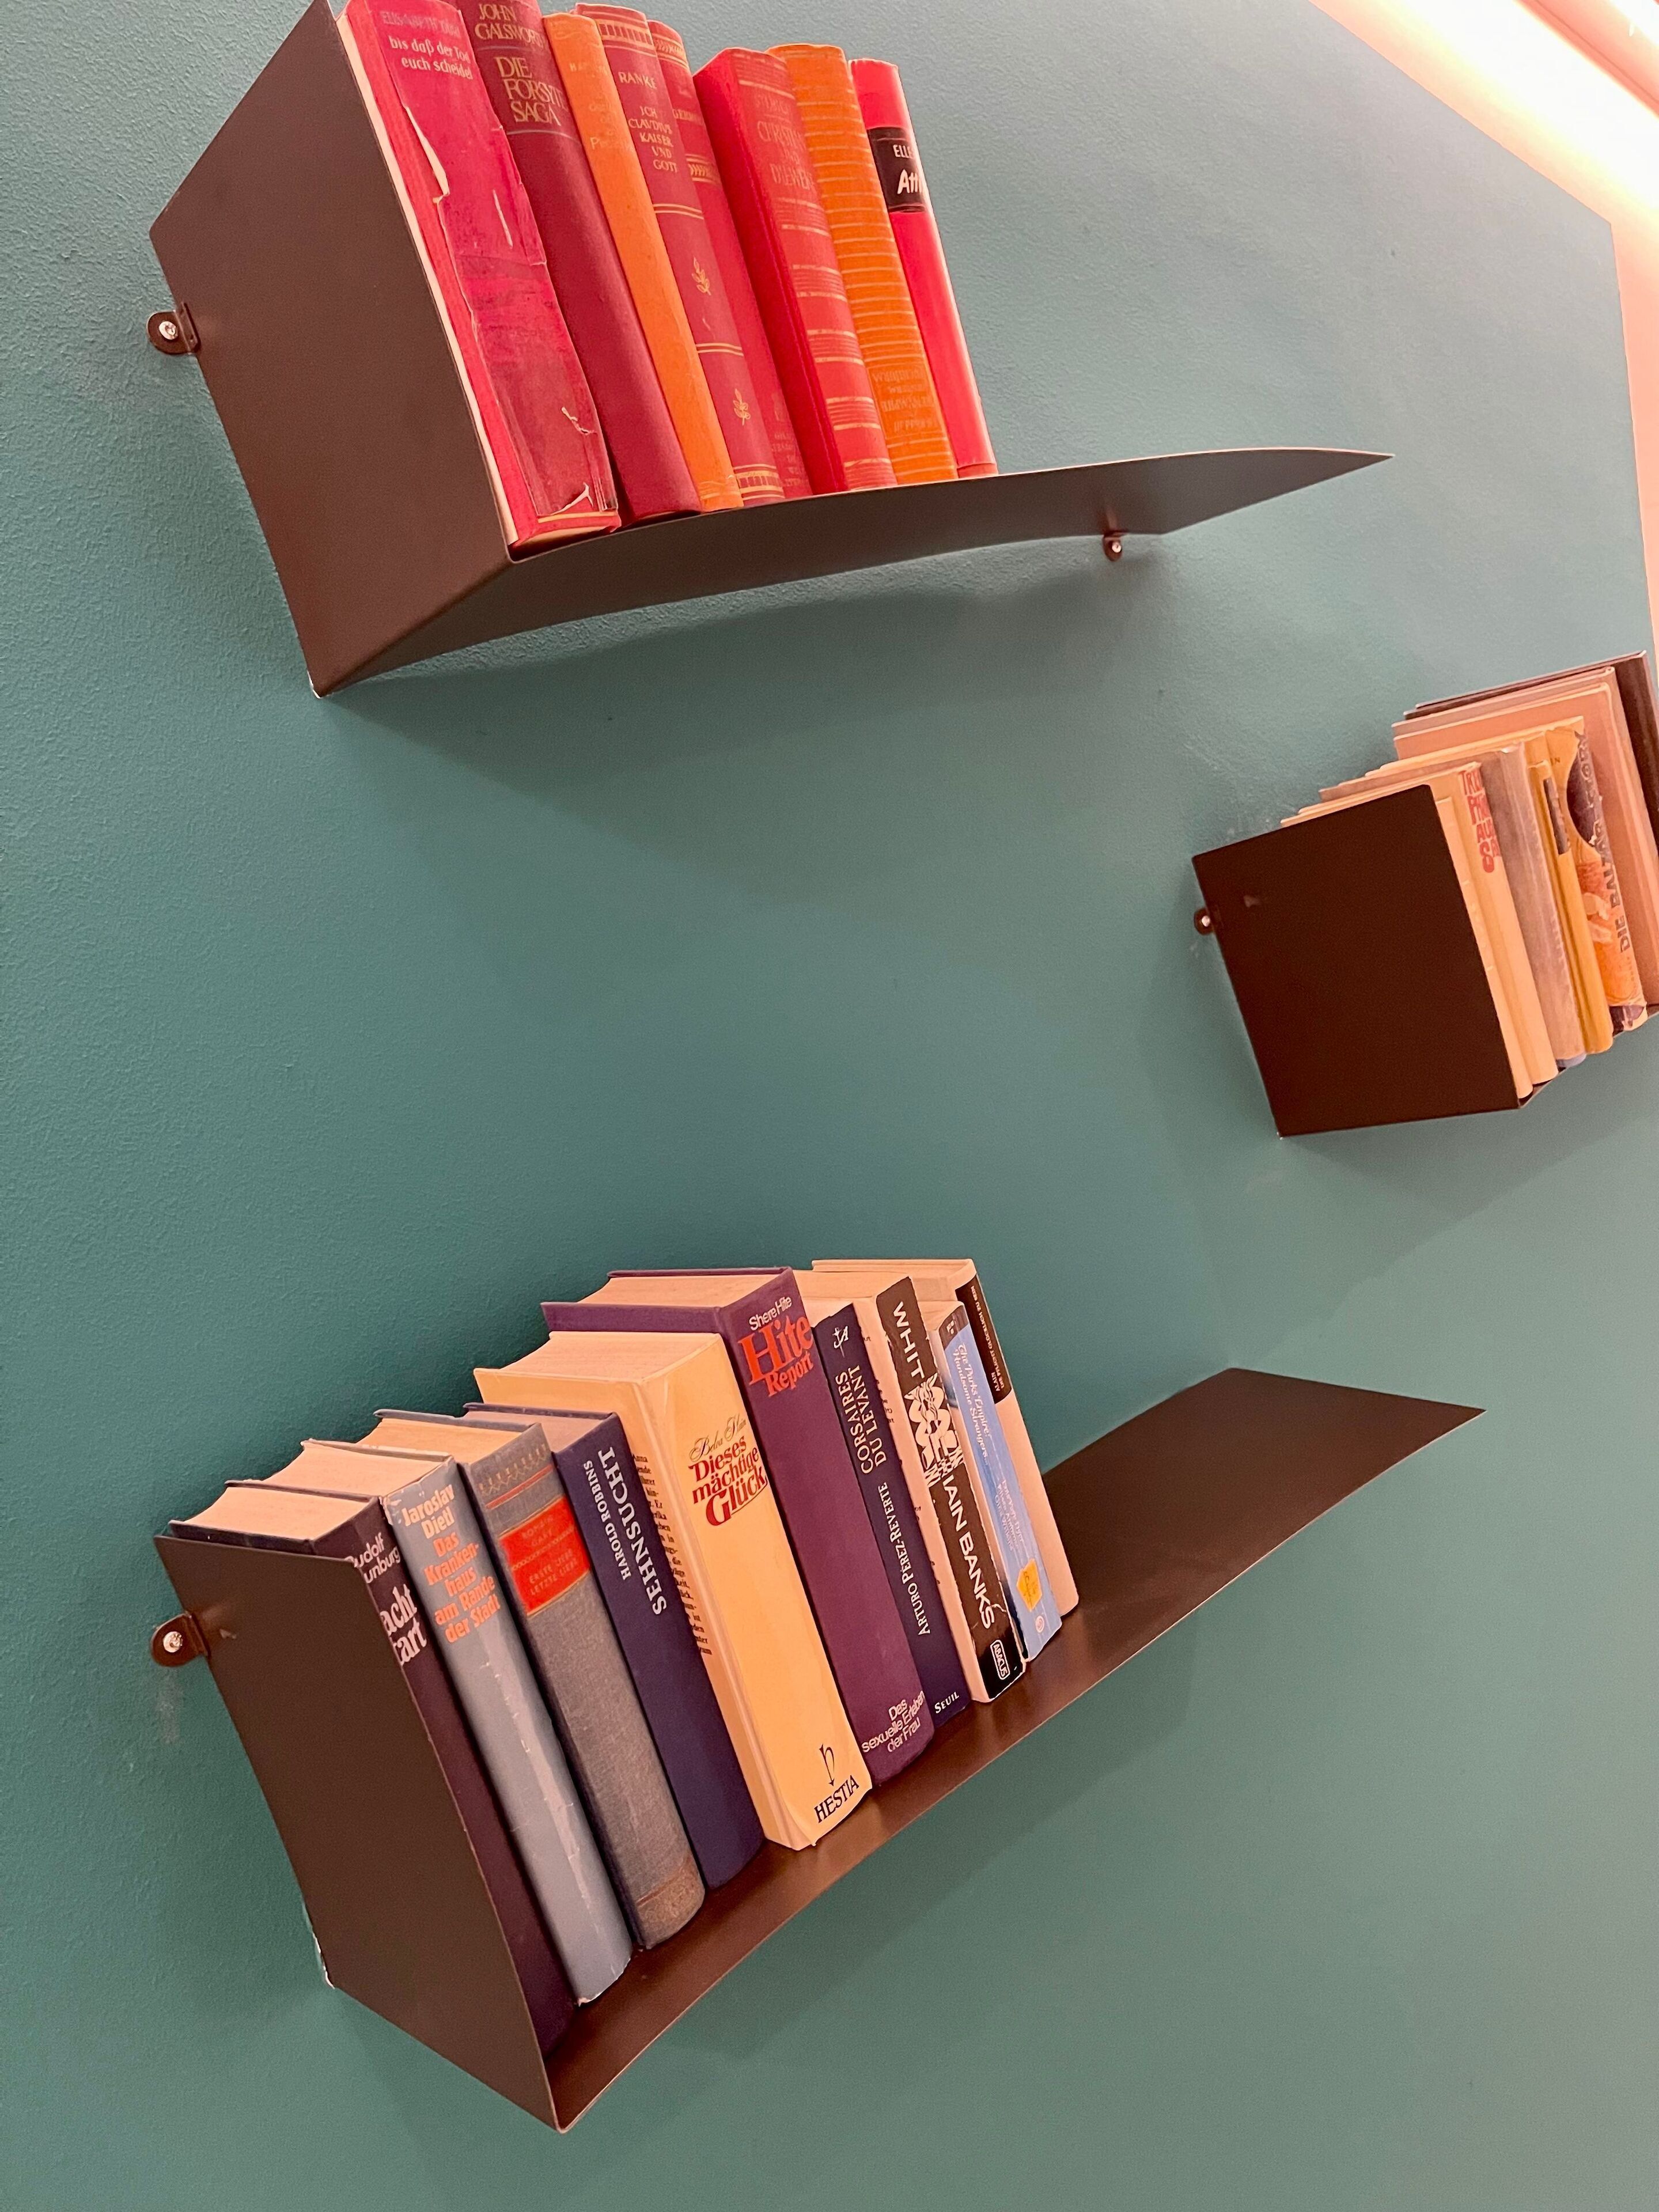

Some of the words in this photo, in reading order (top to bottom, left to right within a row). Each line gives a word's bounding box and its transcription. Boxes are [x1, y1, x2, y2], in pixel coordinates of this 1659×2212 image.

[479, 3, 517, 21] JOHN
[388, 35, 408, 50] bis
[411, 39, 434, 56] daß
[437, 41, 452, 56] der
[402, 56, 431, 70] euch
[495, 56, 532, 78] DIE
[618, 71, 657, 89] RANKE
[511, 101, 561, 126] SAGA
[640, 106, 658, 119] ICH
[640, 132, 673, 147] KAISER
[749, 1308, 778, 1331] Shere
[775, 1296, 793, 1315] Hite
[737, 1315, 813, 1386] Hite
[893, 1301, 925, 1379] WHIT
[764, 1351, 814, 1397] Report
[953, 1350, 972, 1405] Handsome
[958, 1343, 968, 1365] The
[965, 1362, 978, 1396] Parks
[991, 1372, 1001, 1392] ALAIN
[835, 1371, 874, 1474] CORSAIRES
[848, 1365, 877, 1435] LEVANT
[688, 1435, 747, 1482] Dieses
[692, 1446, 759, 1505] mächtige
[869, 1438, 887, 1467] DU
[583, 1460, 612, 1522] ROBBINS
[706, 1466, 766, 1526] Glück
[421, 1506, 455, 1539] Dietl
[433, 1532, 460, 1556] Das
[597, 1446, 667, 1615] SEHNSUCHT
[363, 1546, 401, 1584] unburg
[423, 1542, 479, 1585] Kranken-
[605, 1522, 632, 1581] HAROLD
[942, 1474, 968, 1532] IAIN
[959, 1531, 995, 1630] BANKS
[434, 1603, 459, 1625] am
[459, 1576, 495, 1611] Rande
[444, 1567, 476, 1597] haus
[380, 1584, 417, 1636] acht
[445, 1618, 471, 1642] der
[470, 1594, 501, 1628] Stadt
[907, 1582, 931, 1636] ARTURO
[862, 1719, 904, 1753] sexuelle
[902, 1690, 925, 1725] Erleben
[888, 1699, 908, 1721] Das
[934, 1691, 959, 1714] SEUIL
[887, 1733, 904, 1752] der
[902, 1717, 921, 1741] Frau
[814, 1775, 859, 1823] HESTIA
